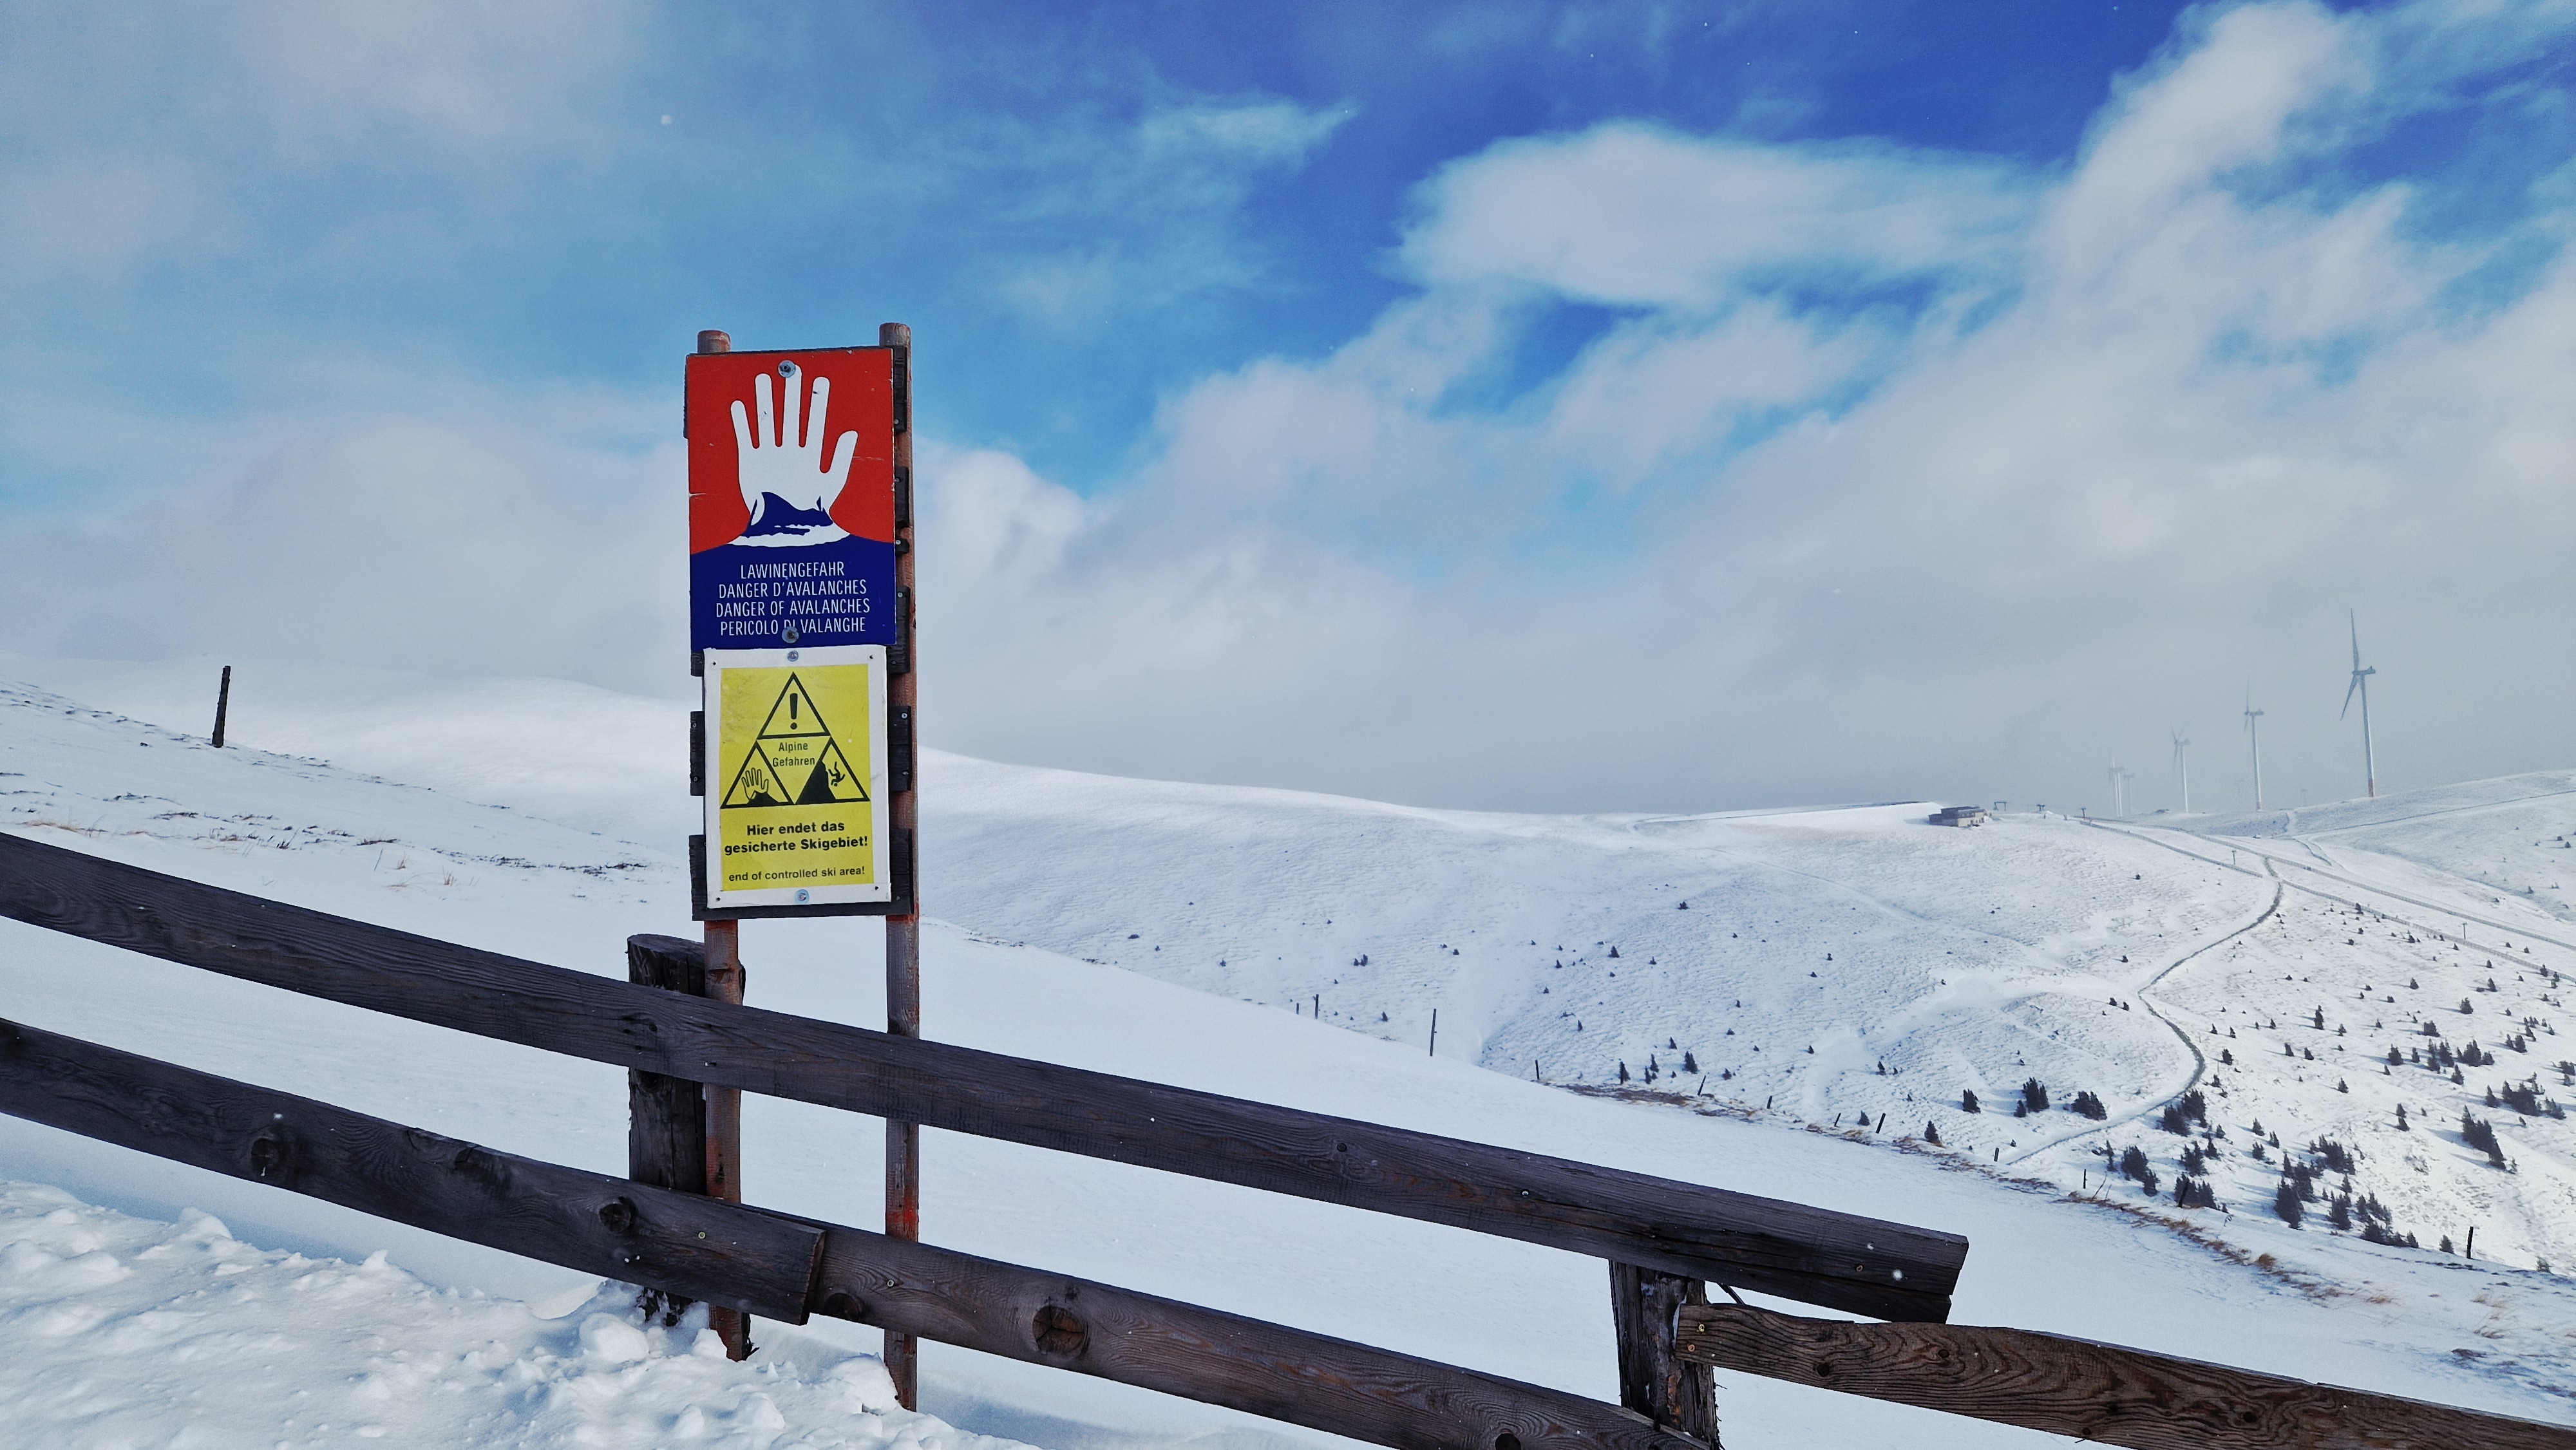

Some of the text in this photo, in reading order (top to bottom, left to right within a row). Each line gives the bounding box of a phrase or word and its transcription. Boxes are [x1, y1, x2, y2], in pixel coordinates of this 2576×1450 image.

[741, 561, 845, 579] LAWINENGEFAHR
[719, 579, 867, 599] DANGER D'AVALANCHES
[716, 598, 870, 617] DANGER OF AVALANCHES
[721, 620, 778, 636] PERICOLO
[800, 617, 866, 634] VALANGHE
[779, 742, 808, 753] Alpine
[772, 757, 815, 767] Gefahren
[746, 821, 845, 836] Hier endet das
[724, 836, 868, 856] gesicherte Skigebiet!
[729, 866, 865, 881] end of controlled ski area!
